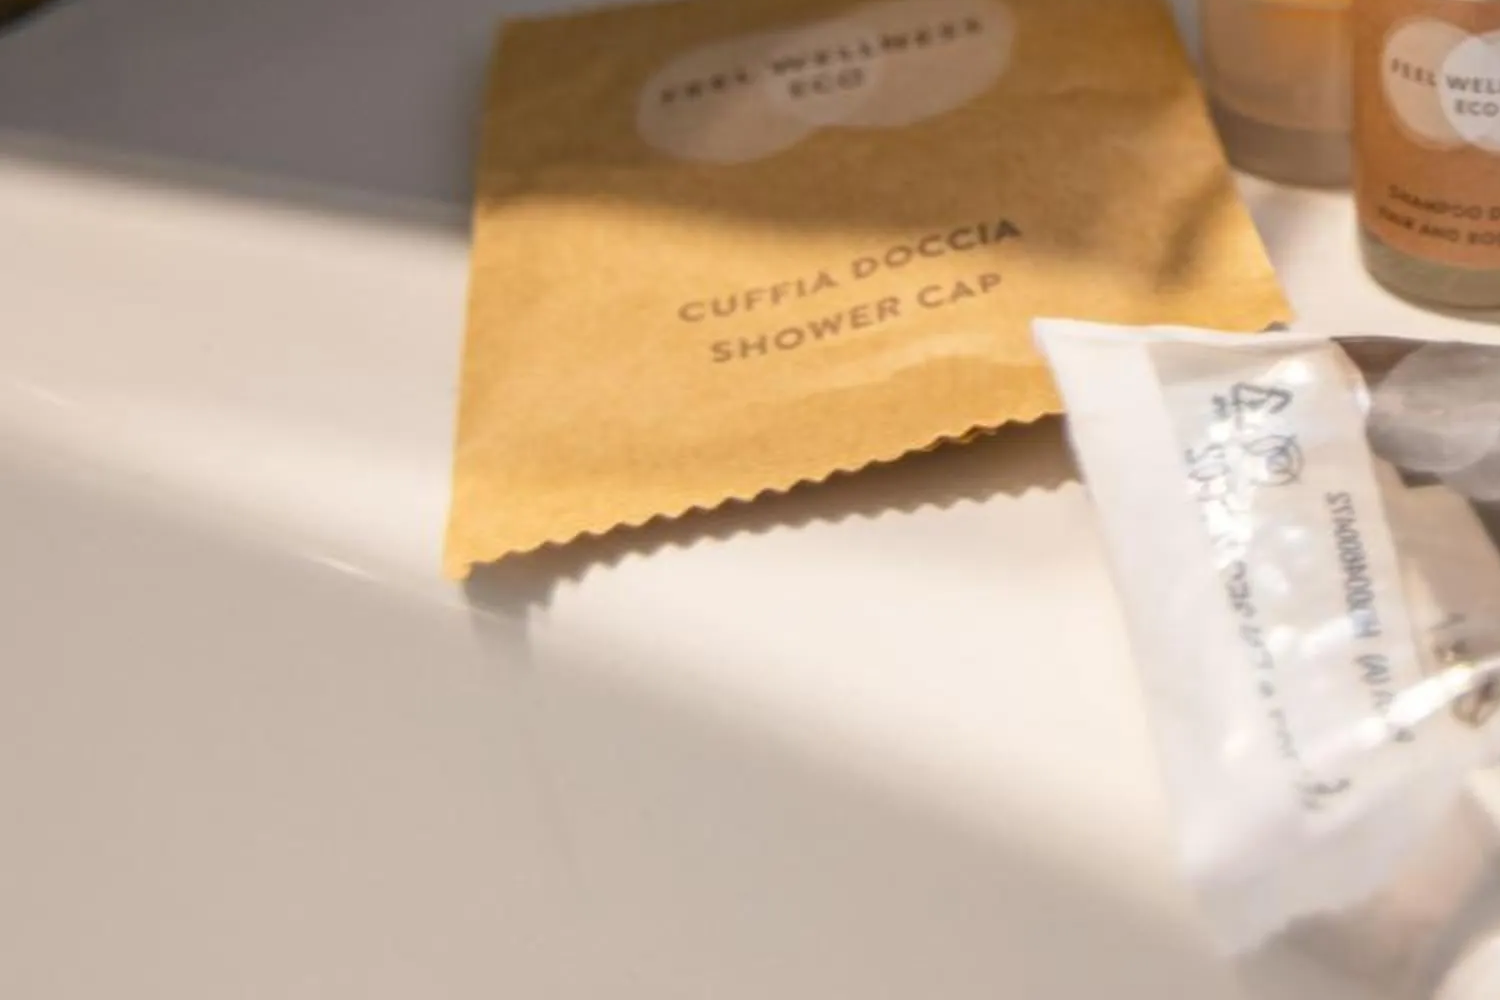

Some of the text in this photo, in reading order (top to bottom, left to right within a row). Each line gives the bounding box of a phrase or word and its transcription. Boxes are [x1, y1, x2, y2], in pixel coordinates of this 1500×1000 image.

[767, 16, 982, 75] WELLNESS
[1391, 58, 1437, 86] FEEL
[1453, 99, 1500, 118] ECO
[1387, 184, 1483, 220] SHAMPOO
[1418, 223, 1460, 243] AND
[677, 217, 1023, 324] CUFFIA DOCCIA
[709, 271, 1003, 364] SHOWER CAP
